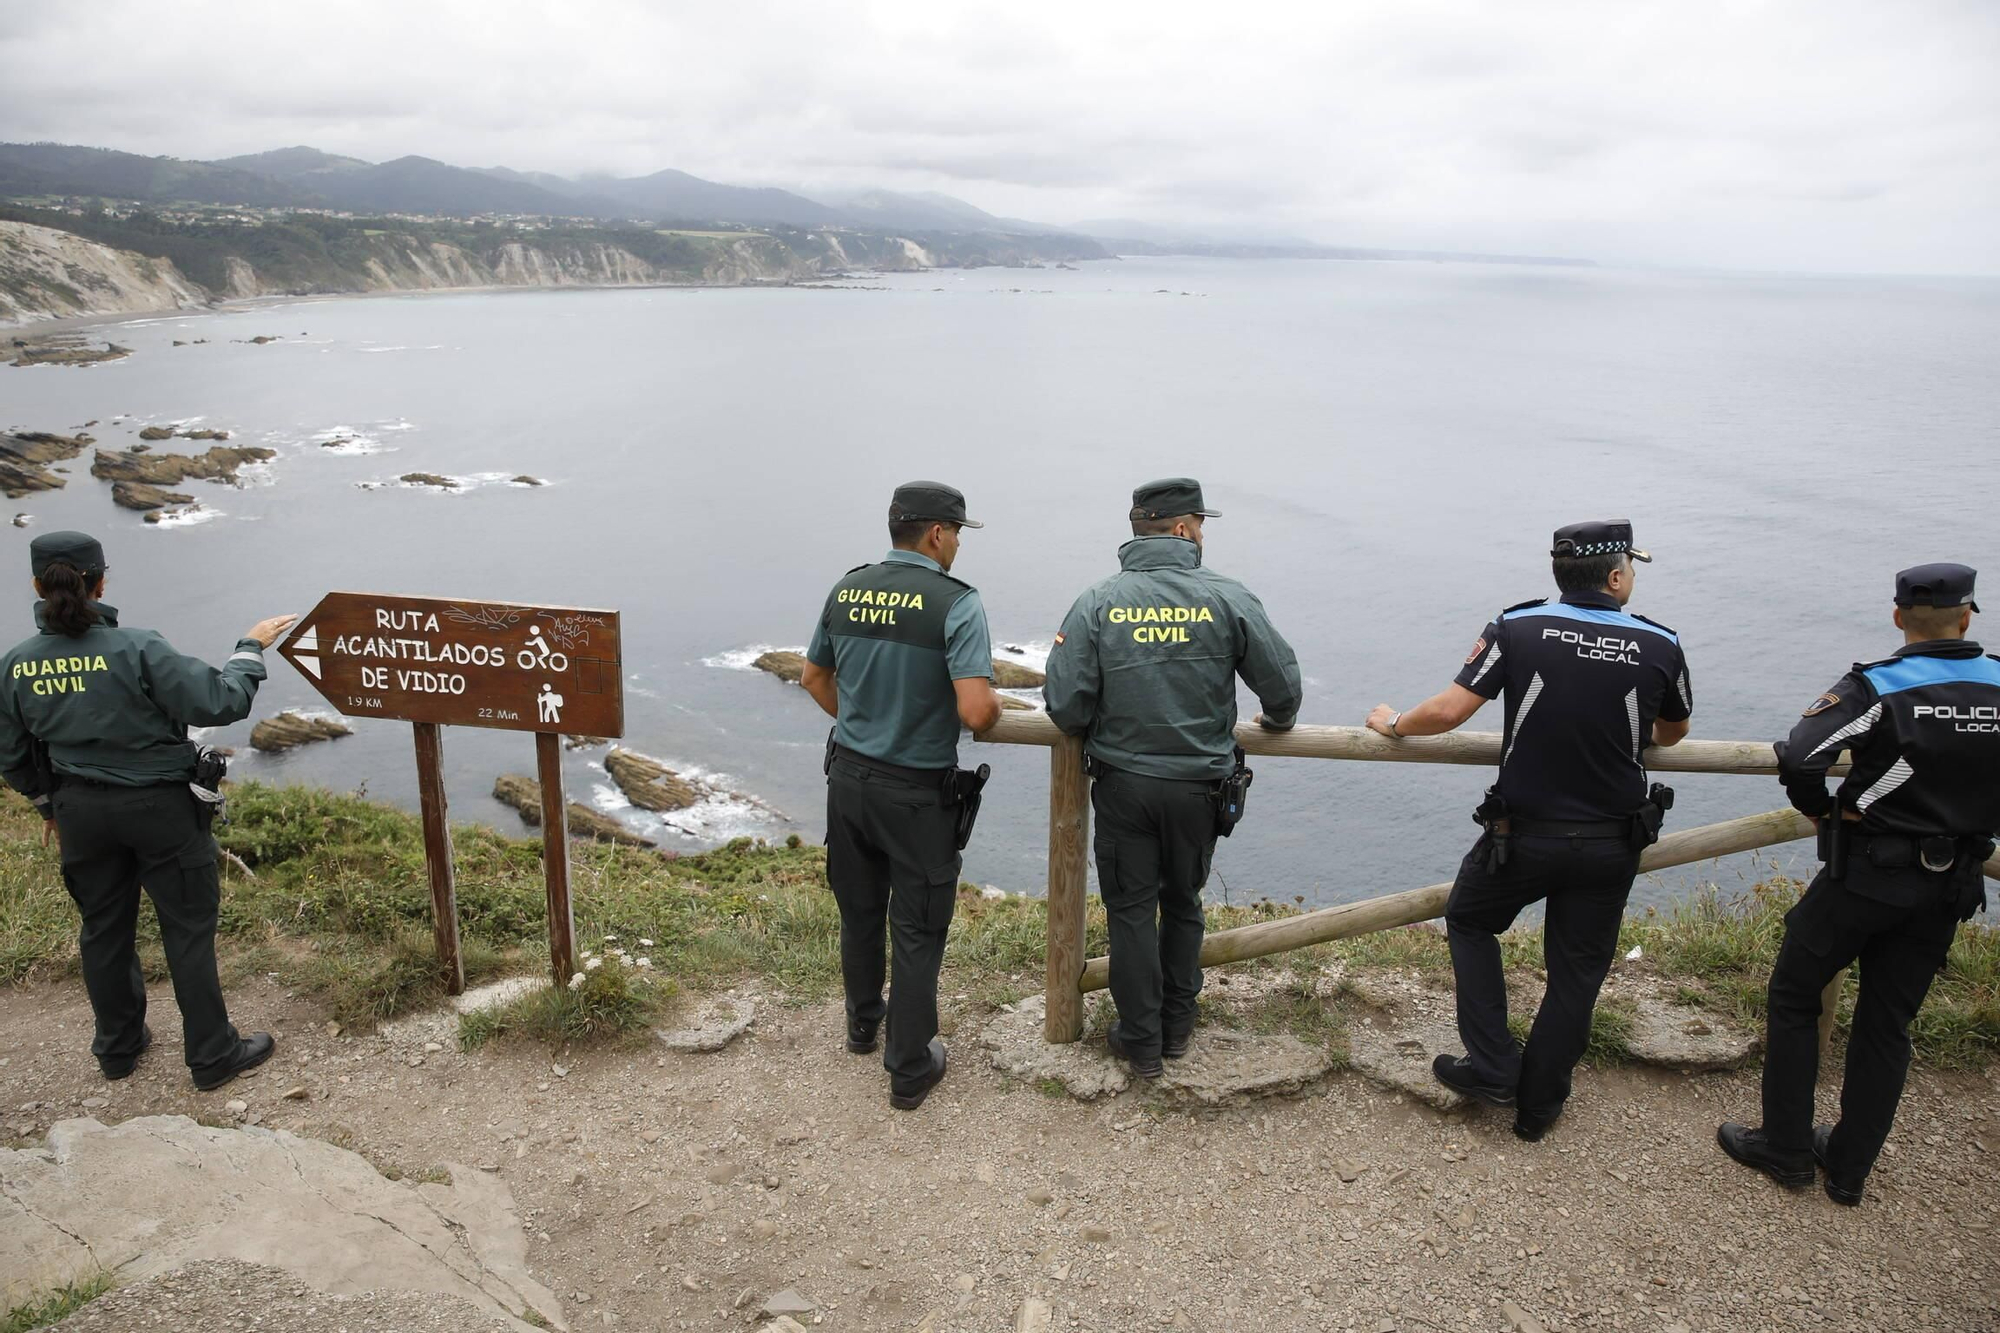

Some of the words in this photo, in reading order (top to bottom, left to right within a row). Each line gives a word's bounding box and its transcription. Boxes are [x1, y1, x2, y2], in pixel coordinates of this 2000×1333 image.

[837, 588, 924, 611] GUARDIA
[375, 607, 440, 633] RUTA
[849, 607, 896, 625] CIVIL
[1108, 607, 1214, 624] GUARDIA
[1132, 626, 1190, 643] CIVIL
[1542, 628, 1641, 654] POLICIA
[332, 634, 506, 668] ACANTILADOS
[1577, 646, 1640, 666] LOCAL
[13, 655, 108, 680] GUARDIA
[32, 676, 86, 696] CIVIL
[361, 666, 389, 690] DE
[397, 669, 466, 695] VIDIO
[365, 697, 383, 709] KM
[478, 707, 493, 718] 22
[1913, 705, 2000, 720] POLICI
